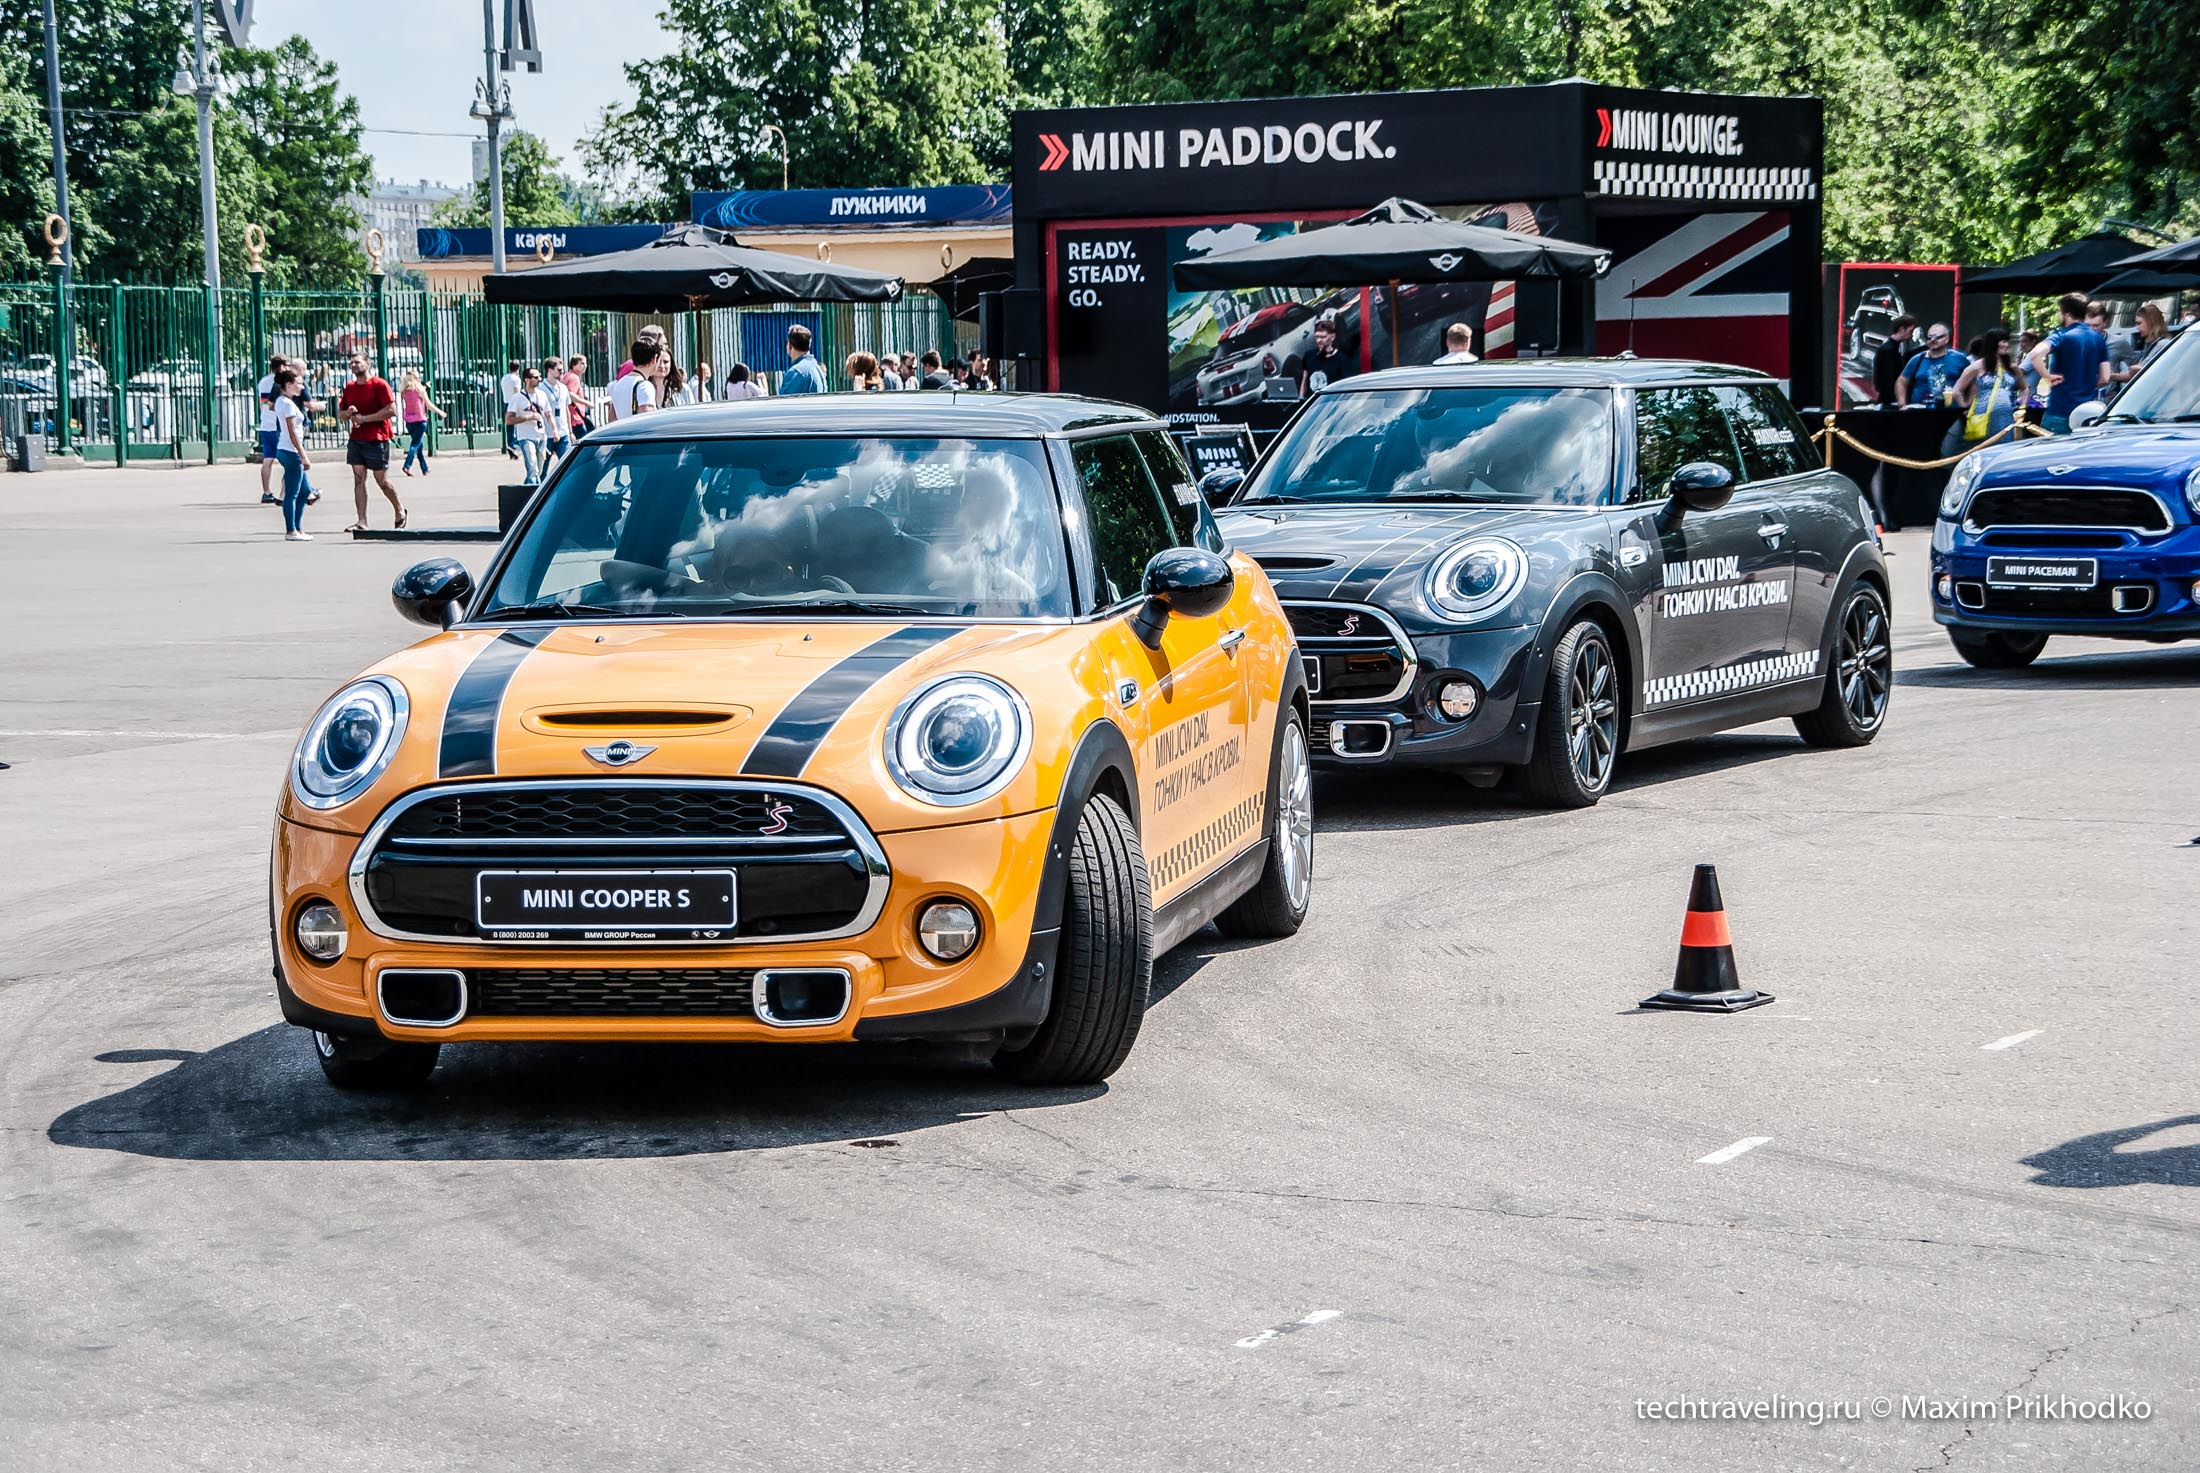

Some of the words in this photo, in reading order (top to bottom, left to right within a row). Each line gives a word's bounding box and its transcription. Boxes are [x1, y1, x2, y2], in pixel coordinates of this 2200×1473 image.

[1612, 109, 1658, 152] MINI
[1662, 112, 1744, 156] LOUNGE.
[1072, 130, 1164, 171] MINI
[1179, 119, 1397, 168] PADDOCK.
[829, 195, 926, 216] ЛУЖНИКИ
[1068, 241, 1136, 260] READY.
[1068, 264, 1145, 284] STEADY.
[1069, 289, 1102, 307] GO.
[1196, 447, 1238, 460] MINI
[1662, 560, 1691, 588] MINI
[1691, 558, 1716, 584] JCW
[1716, 555, 1740, 581] DAY.
[2004, 565, 2027, 575] MINI
[2027, 566, 2077, 577] PACEMAN
[1663, 589, 1705, 618] ГОНКИ
[1714, 585, 1739, 611] НАС
[1747, 580, 1788, 607] КРОВИ.
[1155, 729, 1175, 770] MINI
[1174, 719, 1193, 760] JCW
[1193, 711, 1210, 749] DAY.
[606, 747, 633, 757] MINI
[1153, 768, 1184, 815] ГОНКИ
[1190, 753, 1208, 793] НАС
[1213, 735, 1240, 778] КРОВИ.
[523, 889, 573, 908] MINI
[580, 889, 672, 908] COOPER
[677, 889, 691, 908] S
[493, 931, 499, 939] 8
[499, 931, 518, 940] (800)
[518, 931, 536, 939] 2003
[536, 931, 549, 939] 269
[585, 931, 604, 939] BMW
[604, 931, 630, 939] GROUP
[631, 931, 656, 939] Россия
